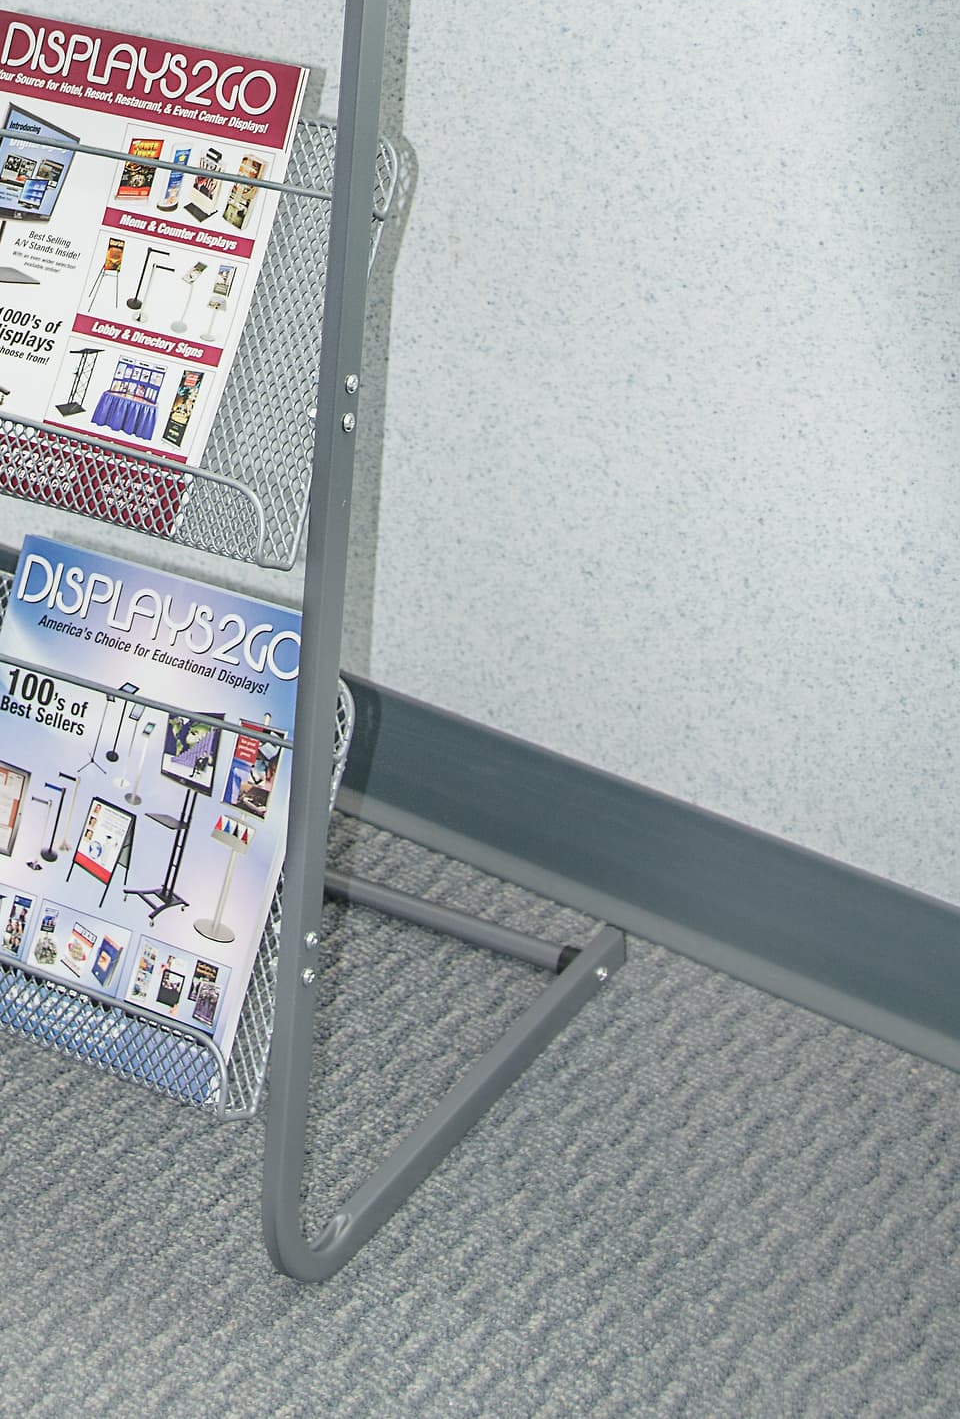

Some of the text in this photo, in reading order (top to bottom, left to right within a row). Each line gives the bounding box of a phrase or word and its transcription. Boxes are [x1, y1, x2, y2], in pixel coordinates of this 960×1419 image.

[1, 21, 277, 115] DISPLAYS2GO
[15, 73, 45, 88] Source
[45, 79, 60, 91] for
[60, 83, 84, 98] Hotel,
[86, 88, 114, 104] Resort,
[115, 93, 163, 115] Restaurant,
[163, 103, 173, 114] &
[173, 105, 198, 120] Event
[198, 110, 227, 126] Center
[228, 117, 269, 134] Displays!
[9, 121, 42, 134] Introducing
[14, 238, 81, 260] A/V Stands Inside!
[28, 230, 71, 249] Best Selling
[119, 213, 238, 251] Menu & Counter Displays
[45, 319, 64, 335] of
[91, 321, 204, 359] Lobby & Directory Signs
[25, 352, 50, 366] from!
[17, 553, 301, 681] DISPLAYS2GO
[38, 614, 270, 695] America's Choice for Educational Displays!
[8, 667, 88, 718] 100's of
[0, 695, 86, 736] Best Sellers
